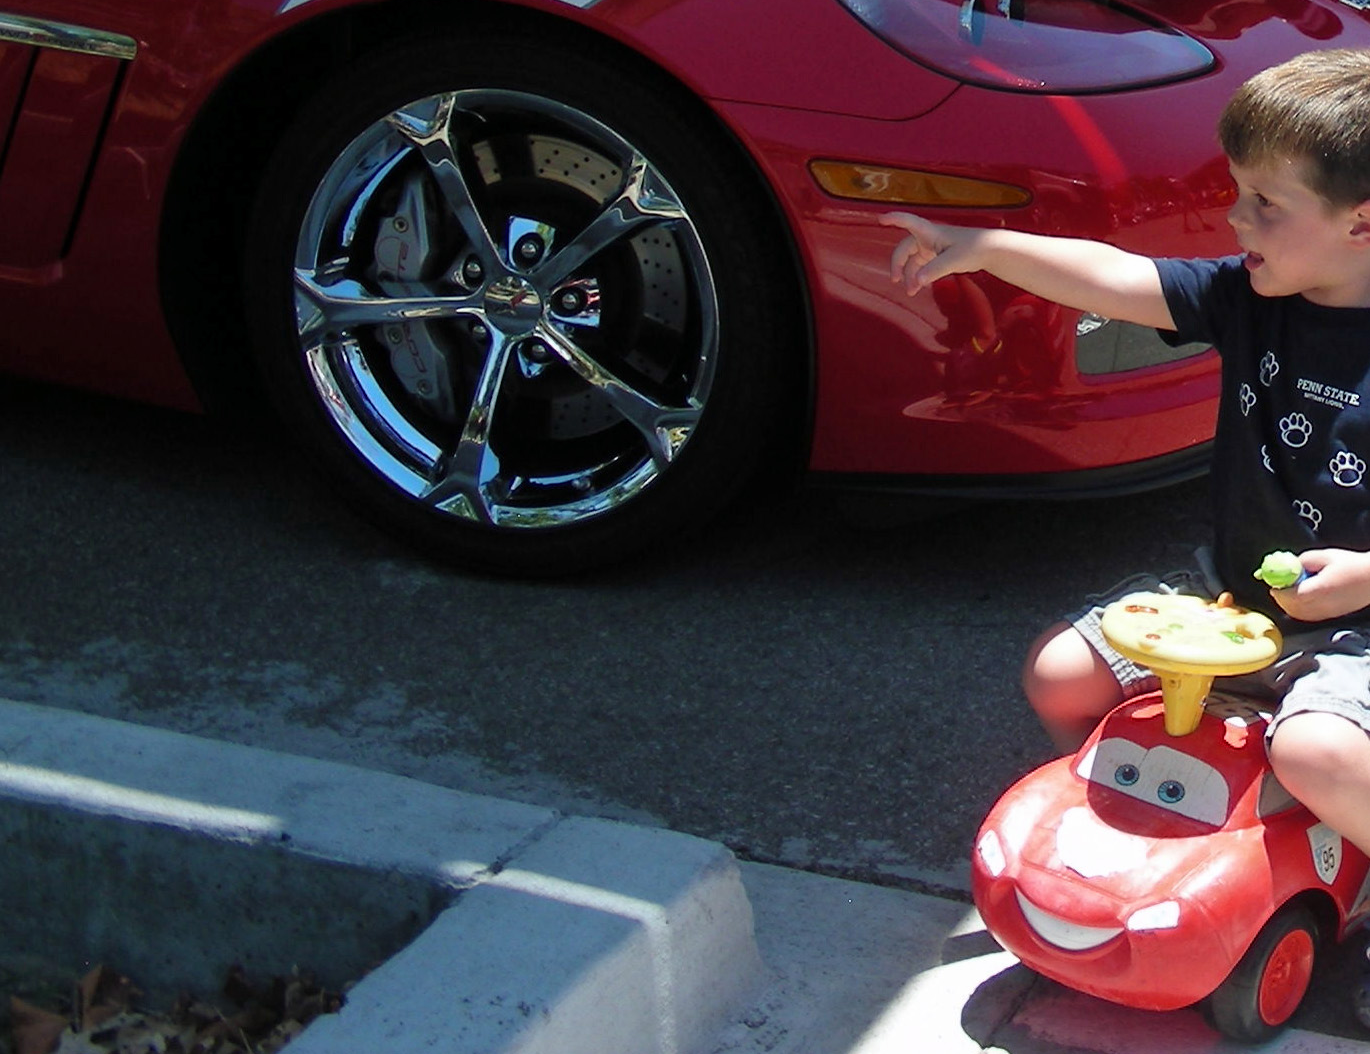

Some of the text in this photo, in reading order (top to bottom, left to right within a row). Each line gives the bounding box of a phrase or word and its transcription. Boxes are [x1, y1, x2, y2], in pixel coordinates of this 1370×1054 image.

[1296, 378, 1360, 406] PENN STATE
[1322, 846, 1335, 873] 95
